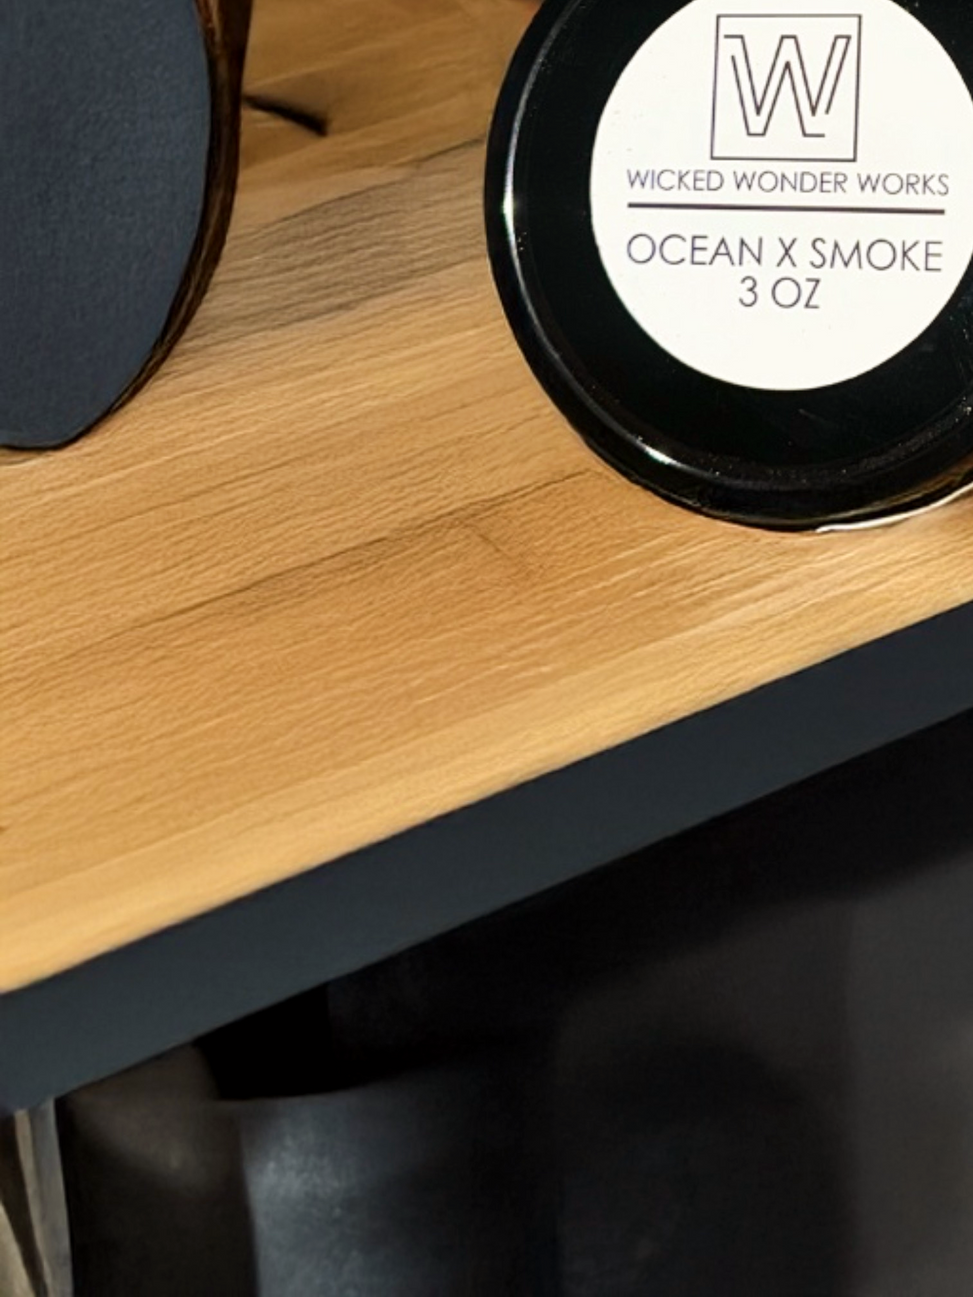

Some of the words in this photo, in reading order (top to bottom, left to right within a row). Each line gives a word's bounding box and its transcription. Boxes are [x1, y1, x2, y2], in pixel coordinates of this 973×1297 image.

[723, 33, 852, 138] W
[627, 169, 724, 191] WICKED
[733, 171, 848, 193] WONDER
[857, 172, 950, 196] WORKS
[627, 233, 762, 266] OCEAN
[777, 237, 797, 267] X
[810, 238, 942, 272] SMOKE
[739, 276, 758, 307] 3
[771, 277, 821, 309] OZ
